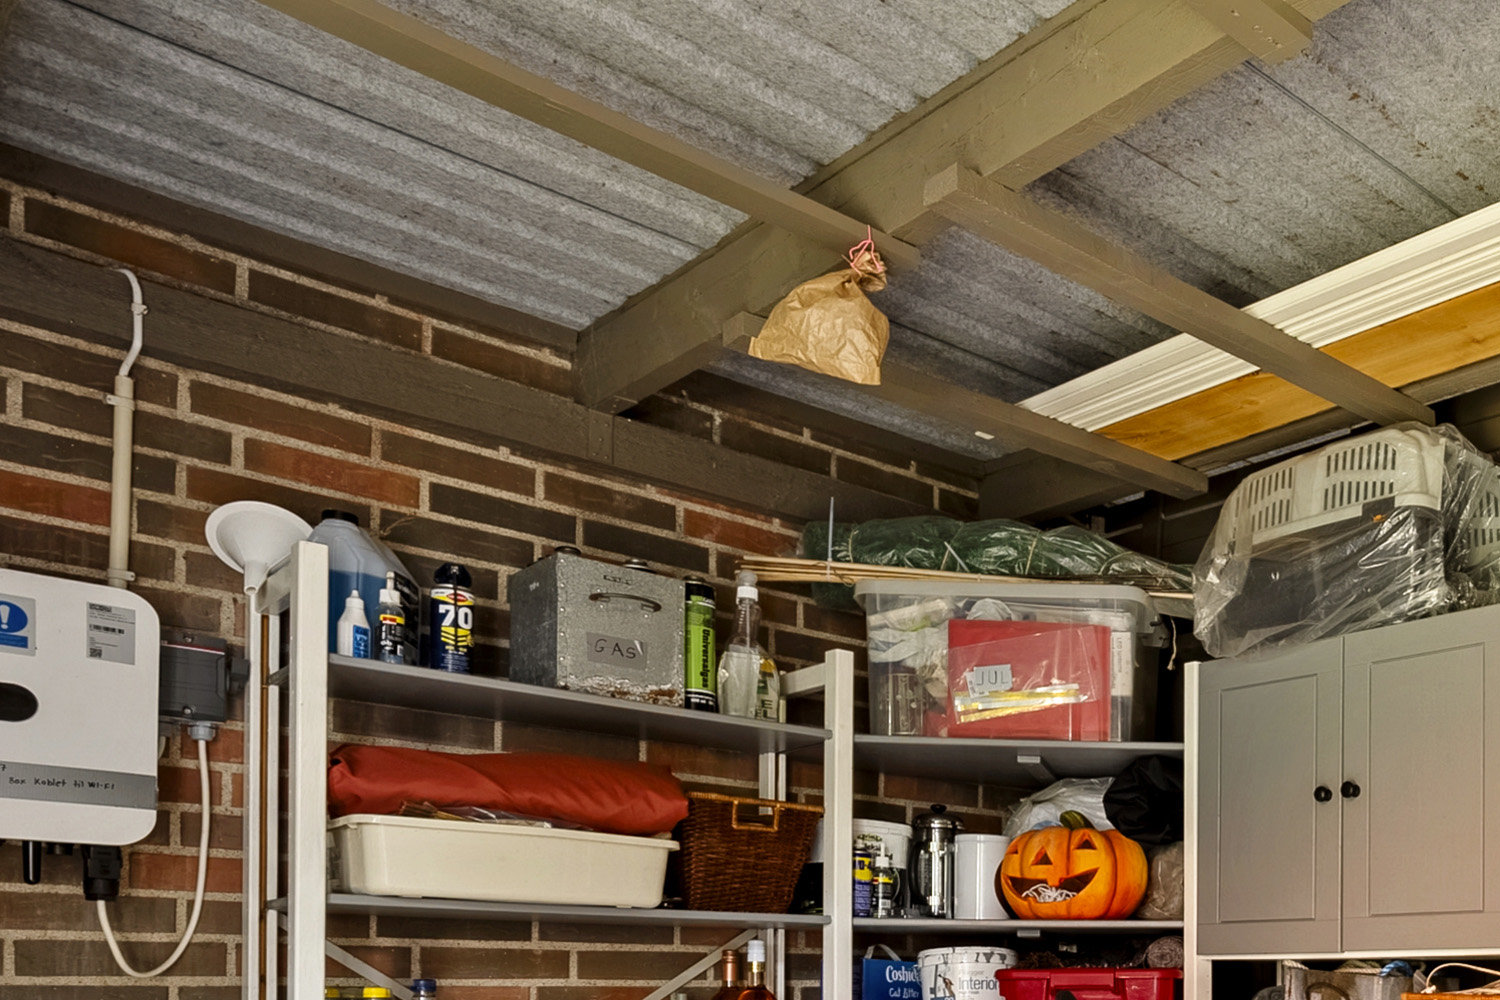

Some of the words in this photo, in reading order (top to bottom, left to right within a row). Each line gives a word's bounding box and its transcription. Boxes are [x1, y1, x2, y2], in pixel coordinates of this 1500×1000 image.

[438, 604, 473, 630] 70
[594, 638, 637, 659] GAS
[700, 628, 710, 688] Universalgas
[976, 670, 1009, 686] JUL
